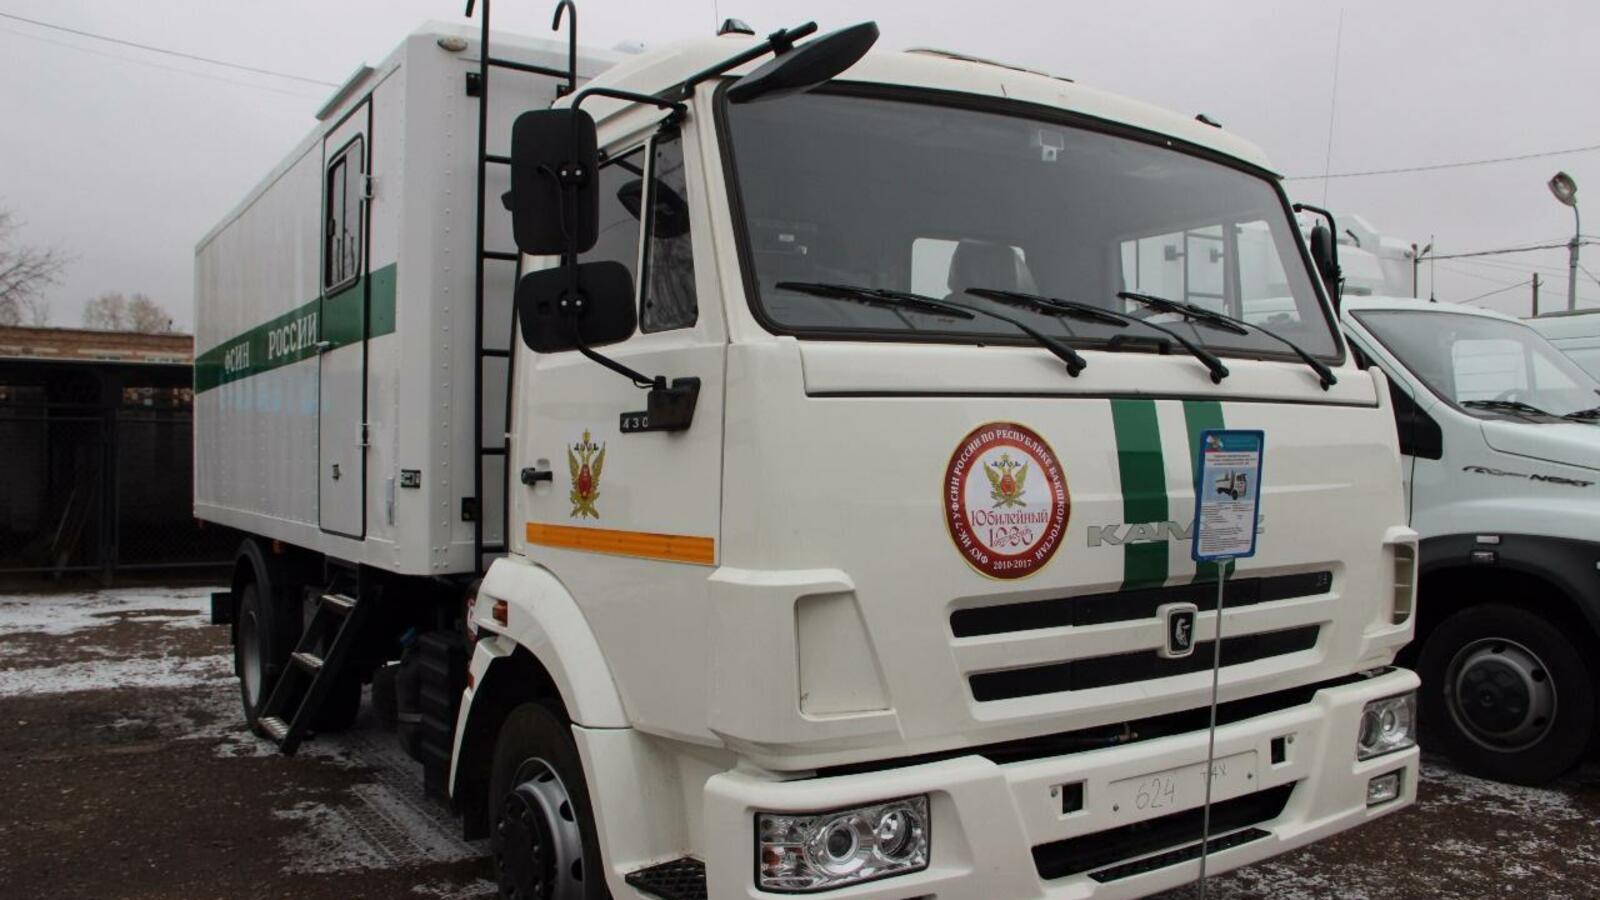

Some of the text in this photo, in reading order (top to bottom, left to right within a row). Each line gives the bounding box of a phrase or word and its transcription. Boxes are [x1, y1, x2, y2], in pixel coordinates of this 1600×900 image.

[224, 312, 317, 374] ФСИН РОССИИ
[980, 431, 995, 443] ПО
[995, 429, 1055, 466] РЕСПУБЛИКЕ
[953, 438, 981, 476] РОССИИ
[950, 476, 960, 519] УФСИН
[970, 509, 1048, 527] Юбилейный
[954, 522, 972, 548] ИК-7
[969, 547, 988, 565] ФКУ
[993, 560, 1032, 570] 2010-2017
[1135, 776, 1175, 810] 624
